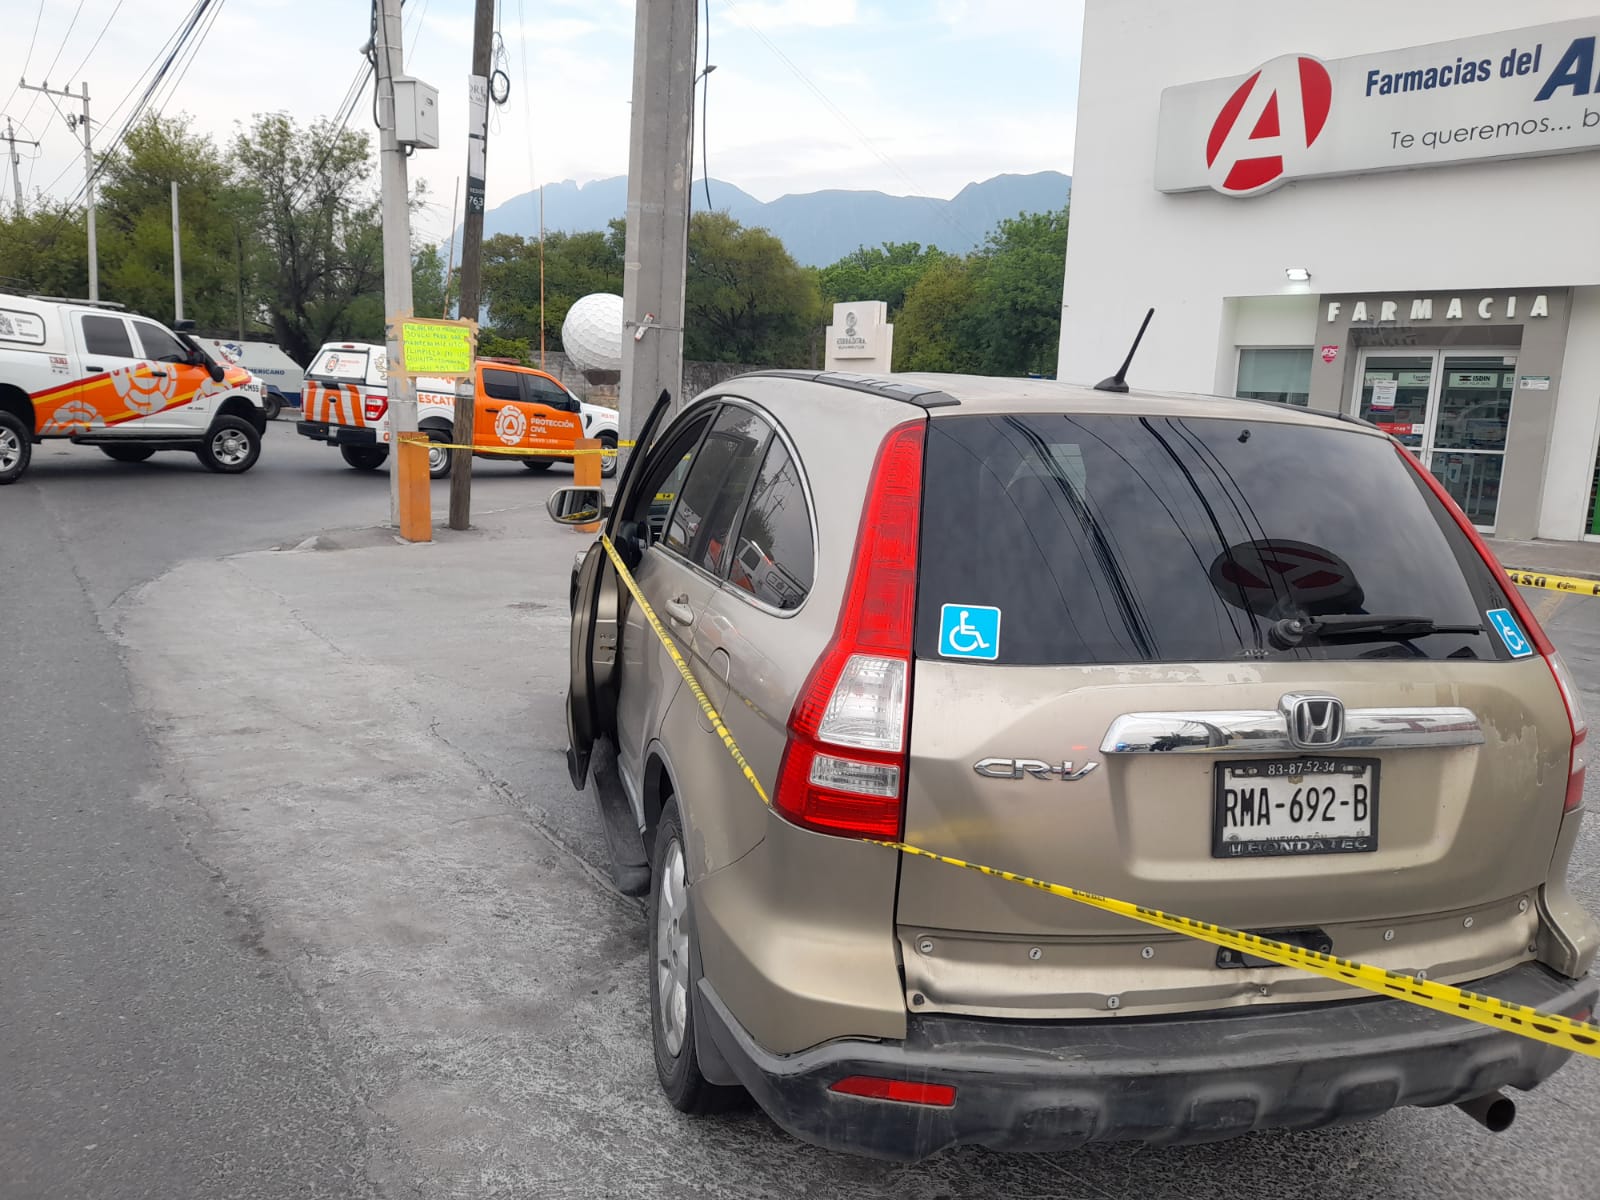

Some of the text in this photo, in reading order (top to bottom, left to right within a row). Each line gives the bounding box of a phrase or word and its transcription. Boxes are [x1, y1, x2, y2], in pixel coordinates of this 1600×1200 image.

[1365, 36, 1600, 102] Farmacias del A
[1391, 108, 1600, 150] Te queremos... b
[1327, 295, 1549, 322] FARMACIA
[418, 393, 456, 406] ESCAT
[530, 417, 574, 428] PROTECCIÓN
[1511, 573, 1546, 587] ASO
[973, 757, 1099, 781] CR-V
[1224, 784, 1368, 827] RMA-692-B
